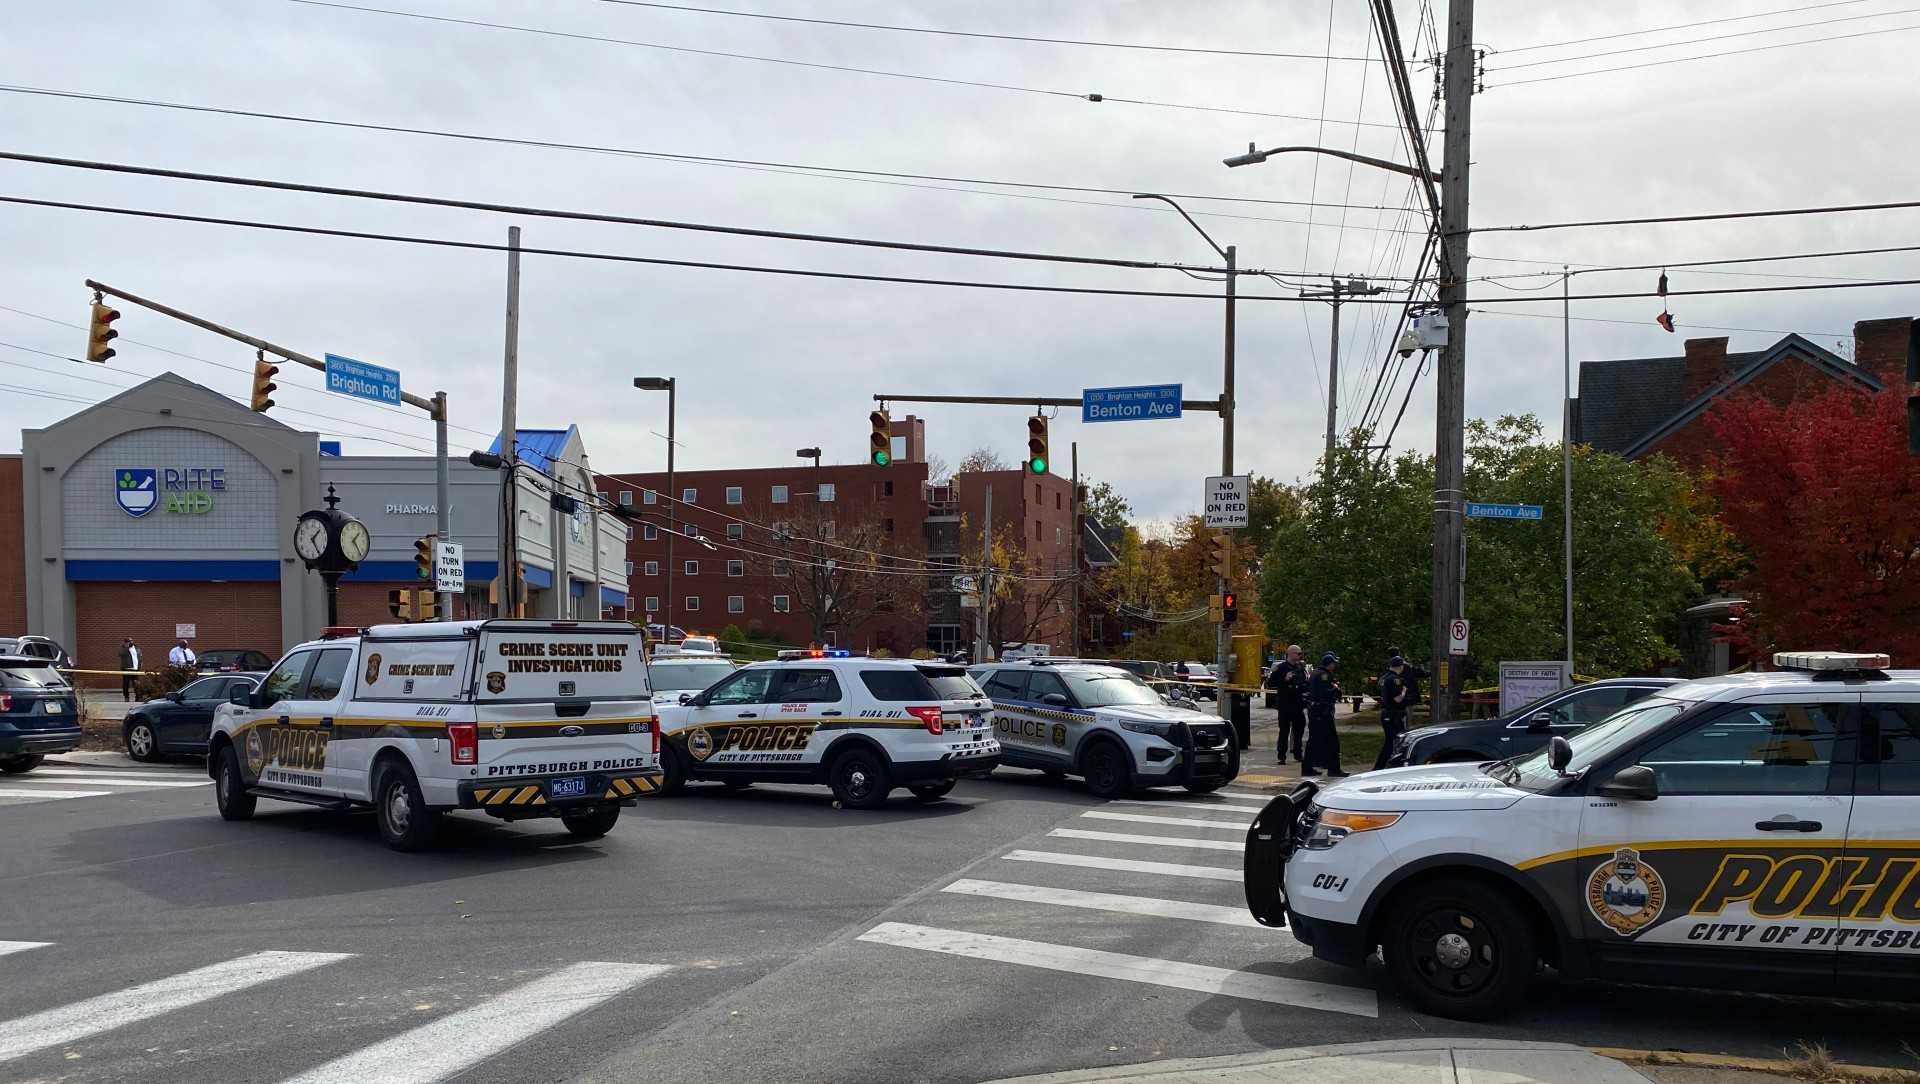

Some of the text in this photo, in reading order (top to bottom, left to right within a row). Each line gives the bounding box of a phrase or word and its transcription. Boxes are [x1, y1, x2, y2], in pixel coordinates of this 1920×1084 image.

[331, 373, 397, 400] Brighton Rd
[1090, 401, 1174, 418] Benton Ave
[164, 469, 225, 490] RITE
[1219, 481, 1234, 490] NO
[166, 491, 213, 514] AID
[1213, 492, 1240, 501] TURN
[1207, 503, 1246, 512] ON RED
[1472, 505, 1538, 517] Benton Ave
[445, 546, 455, 554] NO
[441, 557, 459, 566] TURN
[438, 567, 463, 577] ON RED
[499, 643, 628, 657] CRIME SCENE UNIT
[388, 664, 455, 676] CRIME SCENE UNIT
[508, 659, 623, 673] INVESTIGATIONS
[860, 710, 903, 718] DIAL 911
[989, 716, 1046, 739] POLICE
[720, 725, 816, 752] POLICE
[268, 727, 330, 771] POLICE
[719, 753, 803, 761] CITY OF PITTSBURGH
[488, 757, 644, 776] PITTSBURGH POLICE
[267, 770, 322, 788] CITY OF PITTSBURGH
[1312, 873, 1349, 892] CU-1
[1648, 880, 1661, 912] POLICE
[1687, 923, 1756, 941] CITY
[1759, 925, 1800, 944] OF
